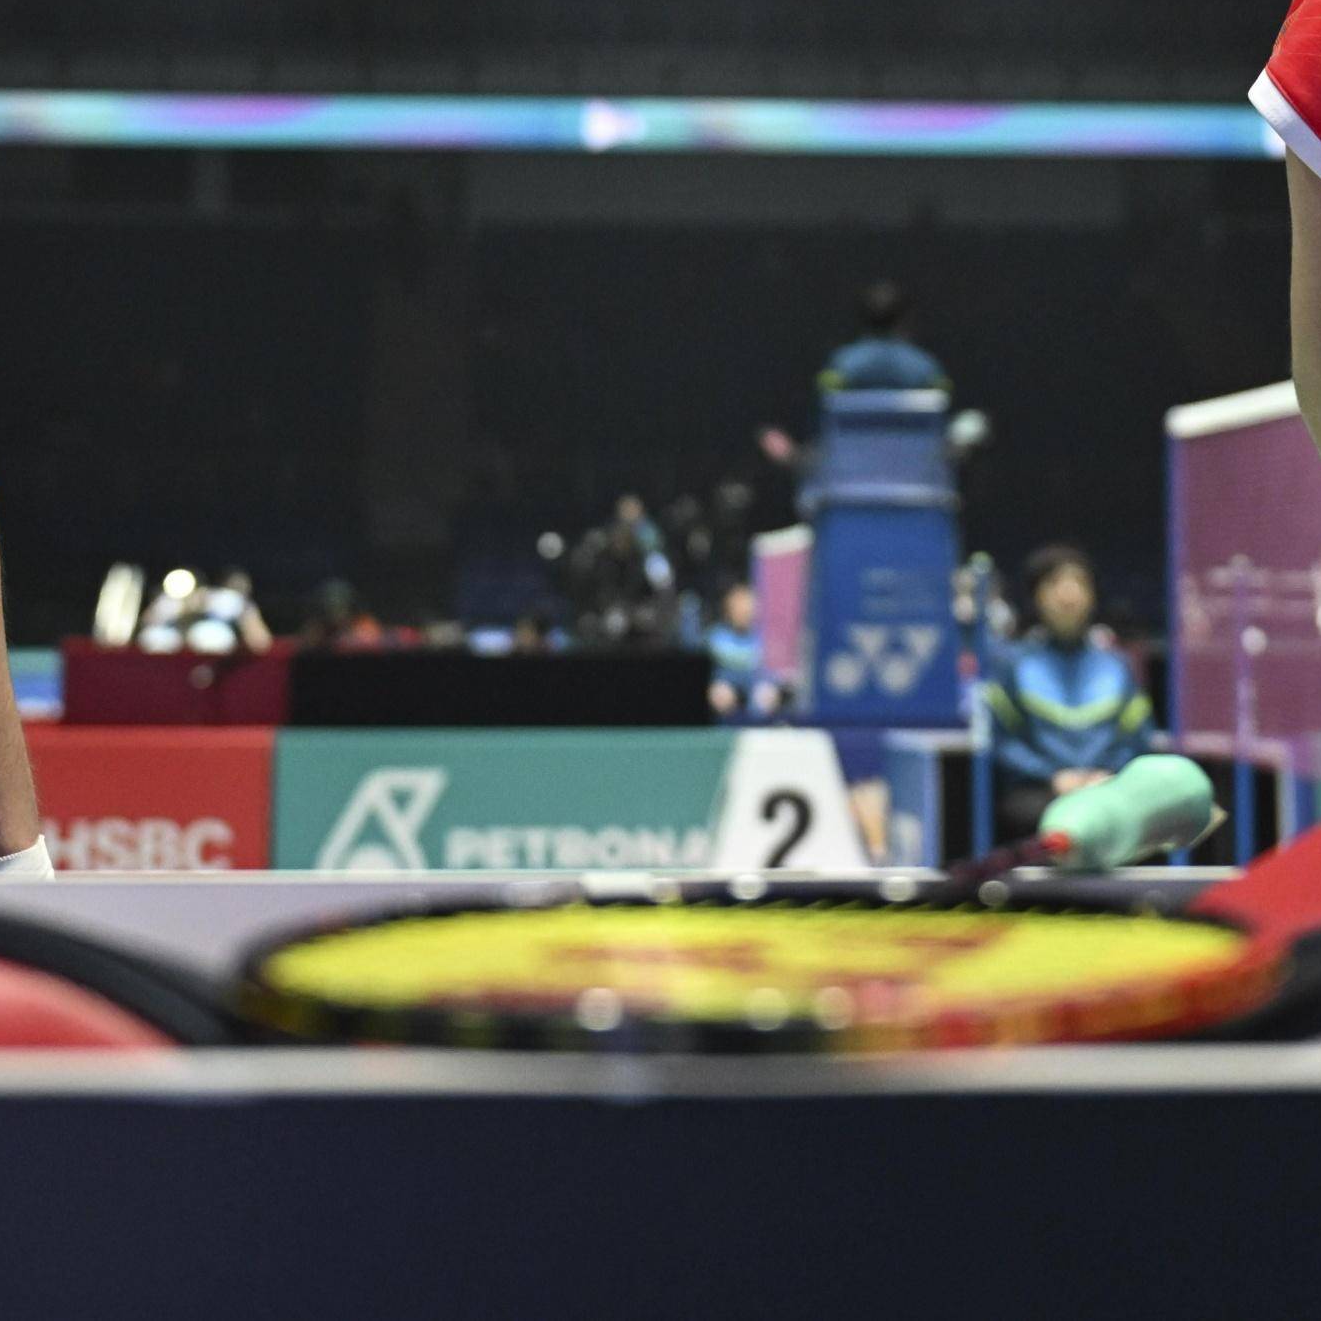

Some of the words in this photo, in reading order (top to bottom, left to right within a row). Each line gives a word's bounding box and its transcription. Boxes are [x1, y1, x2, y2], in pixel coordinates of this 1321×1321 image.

[41, 815, 235, 871] HSBC
[444, 824, 715, 870] PETRONA
[760, 789, 815, 868] 2
